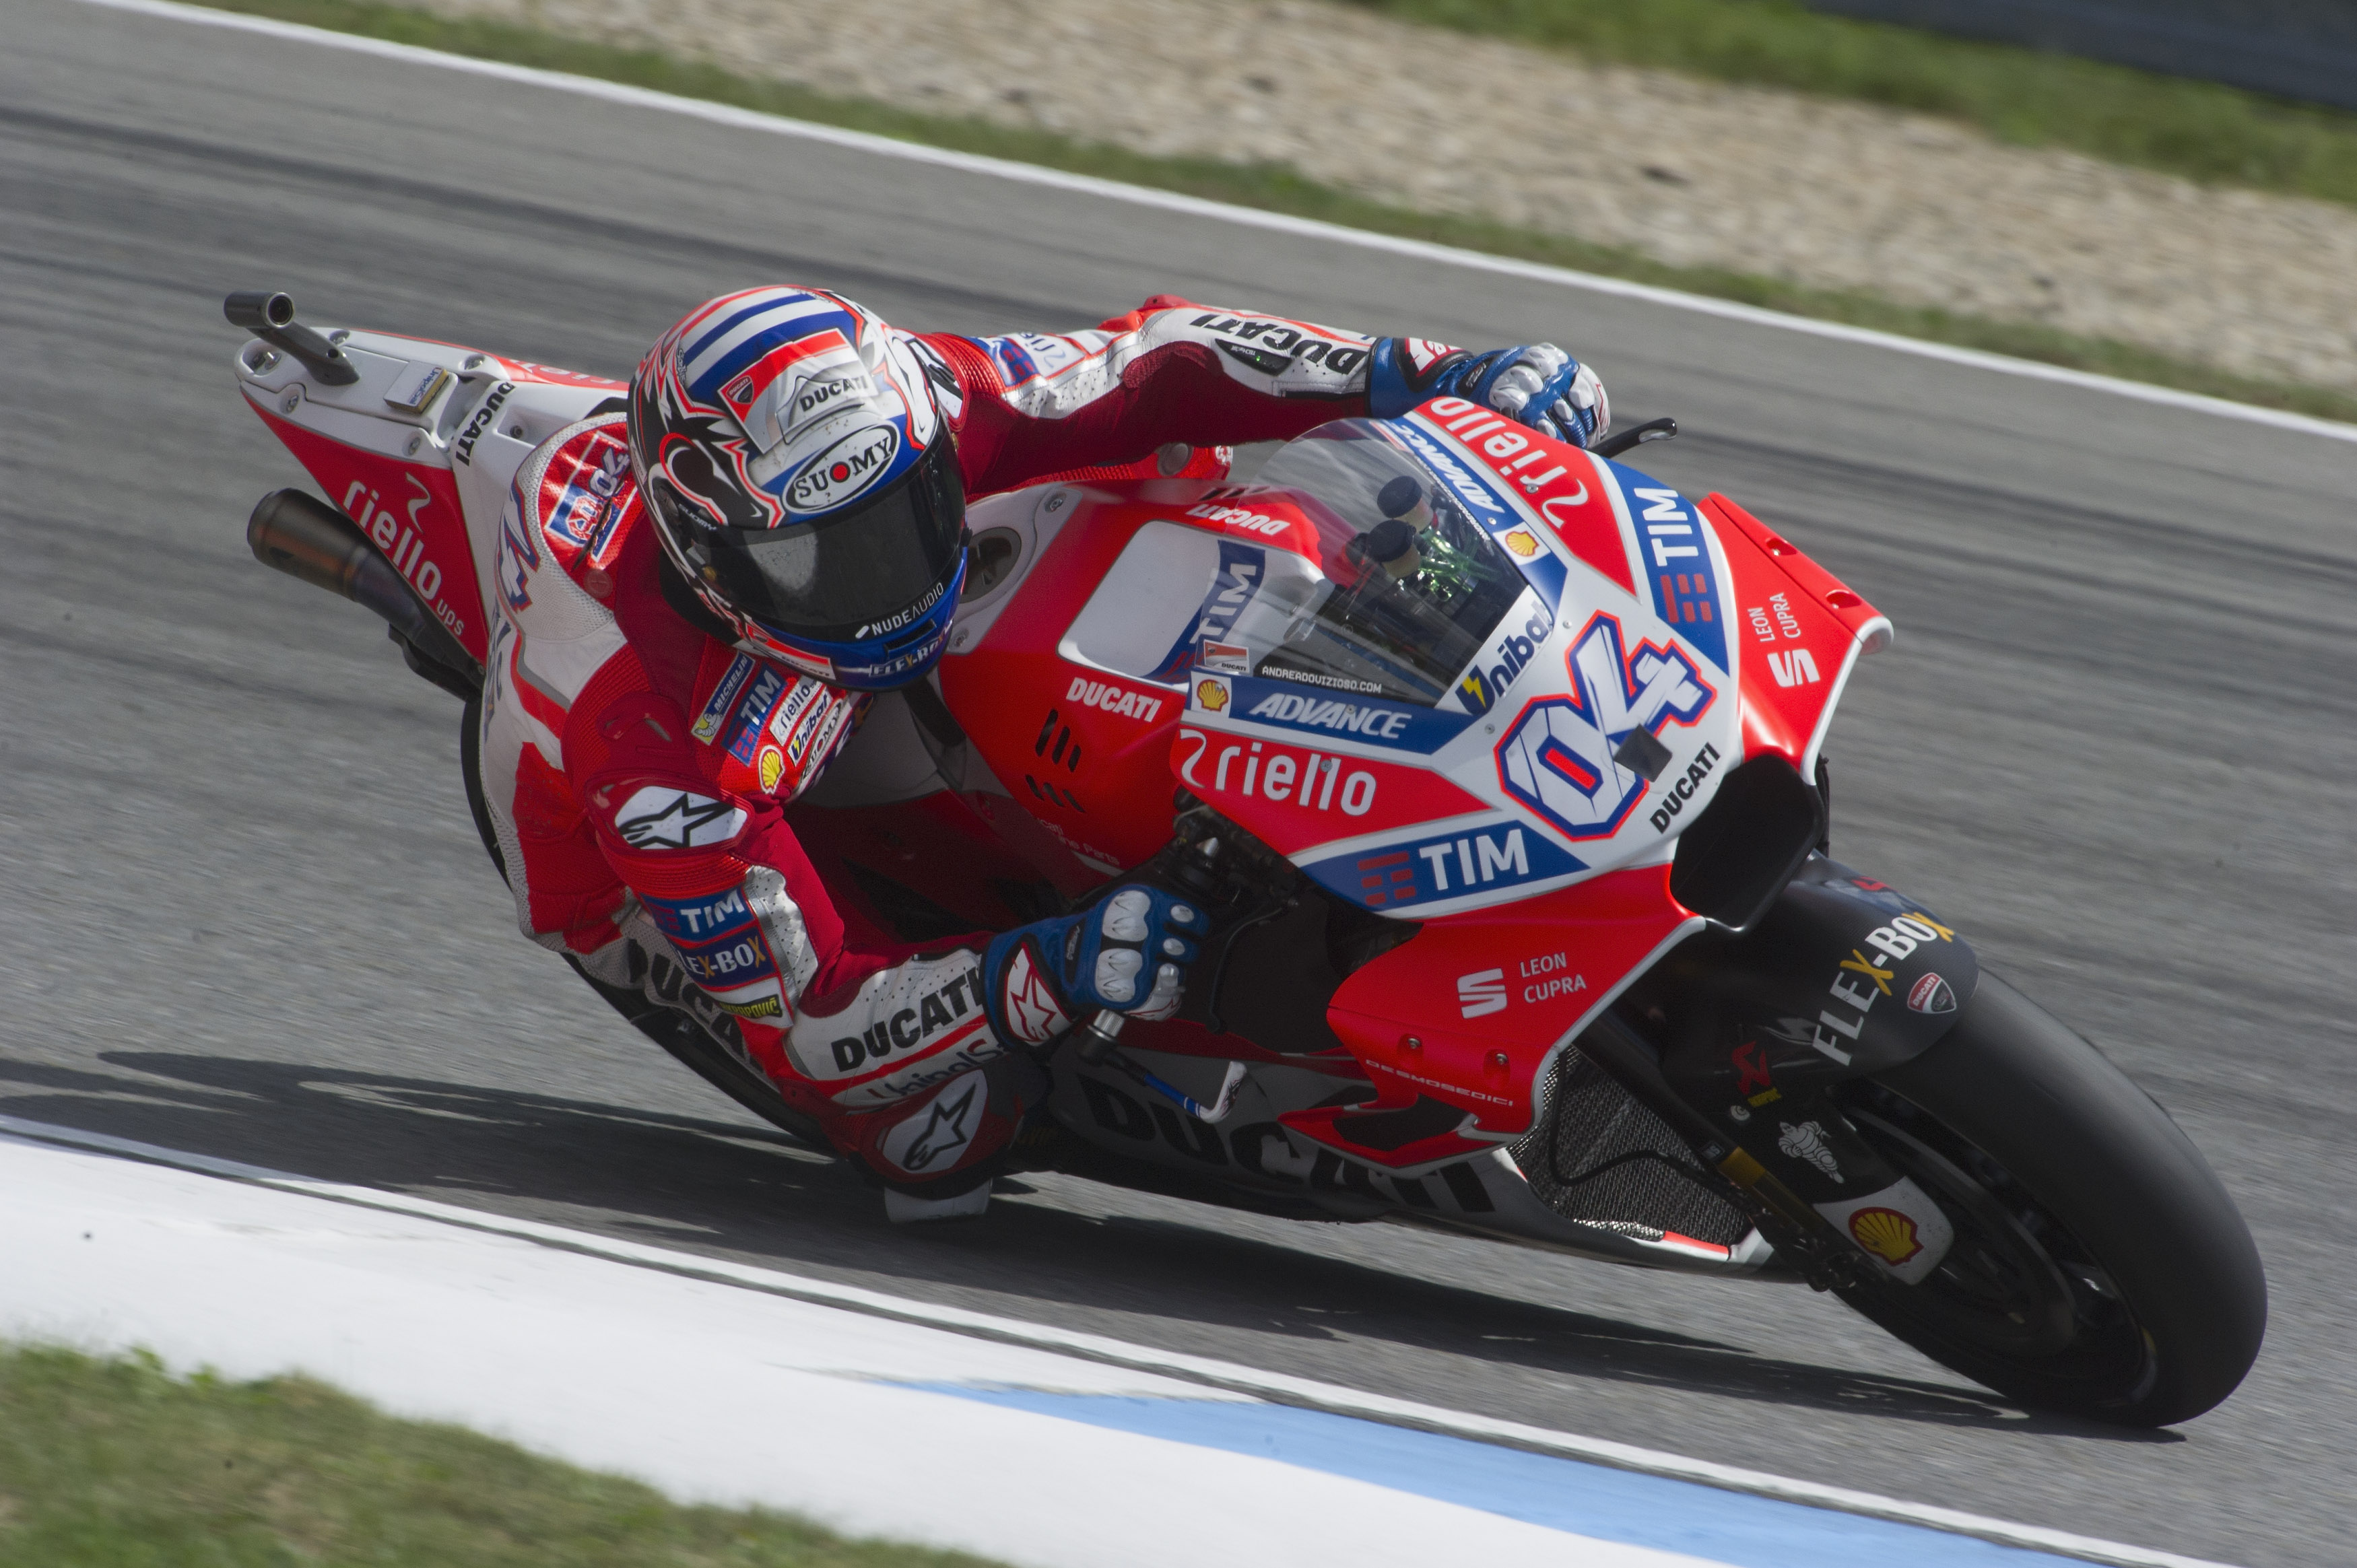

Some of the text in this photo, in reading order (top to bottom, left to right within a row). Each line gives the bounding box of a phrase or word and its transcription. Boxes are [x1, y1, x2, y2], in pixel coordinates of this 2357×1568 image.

[1189, 314, 1369, 375] DUCATI
[799, 376, 869, 412] DUCATI
[456, 382, 516, 466] DUCATI
[1430, 396, 1568, 489] riello
[795, 437, 892, 499] SUOMY
[1186, 503, 1290, 536] DUCATI
[1634, 487, 1699, 567] TIM
[343, 480, 465, 636] riello ups
[1189, 564, 1257, 645] TIM
[1748, 607, 1776, 642] LEON
[1769, 592, 1801, 638] CUPRA
[715, 656, 748, 712] MICHELIN
[1222, 662, 1247, 672] DUCATI
[1262, 666, 1382, 694] ANDREADOVIZIOSO.COM
[741, 669, 782, 726] TIM
[780, 685, 811, 728] riello
[1066, 677, 1162, 724] DUCATI
[1249, 693, 1412, 739] ADVANCE
[1494, 609, 1717, 842] 04
[791, 694, 828, 761] Unibat
[1215, 742, 1377, 817] riello
[1650, 742, 1721, 835] DUCATI
[1419, 828, 1529, 892] TIM
[679, 889, 745, 934] TIM
[676, 935, 766, 980] LEX-BOX
[1520, 951, 1568, 978] LEON
[1523, 974, 1587, 1003] CUPRA
[1812, 912, 1955, 1066] FLEX-BOX
[1912, 976, 1937, 1007] DUCATI
[831, 965, 983, 1072] DUCATI
[1366, 1058, 1513, 1107] DESMOSEDICI
